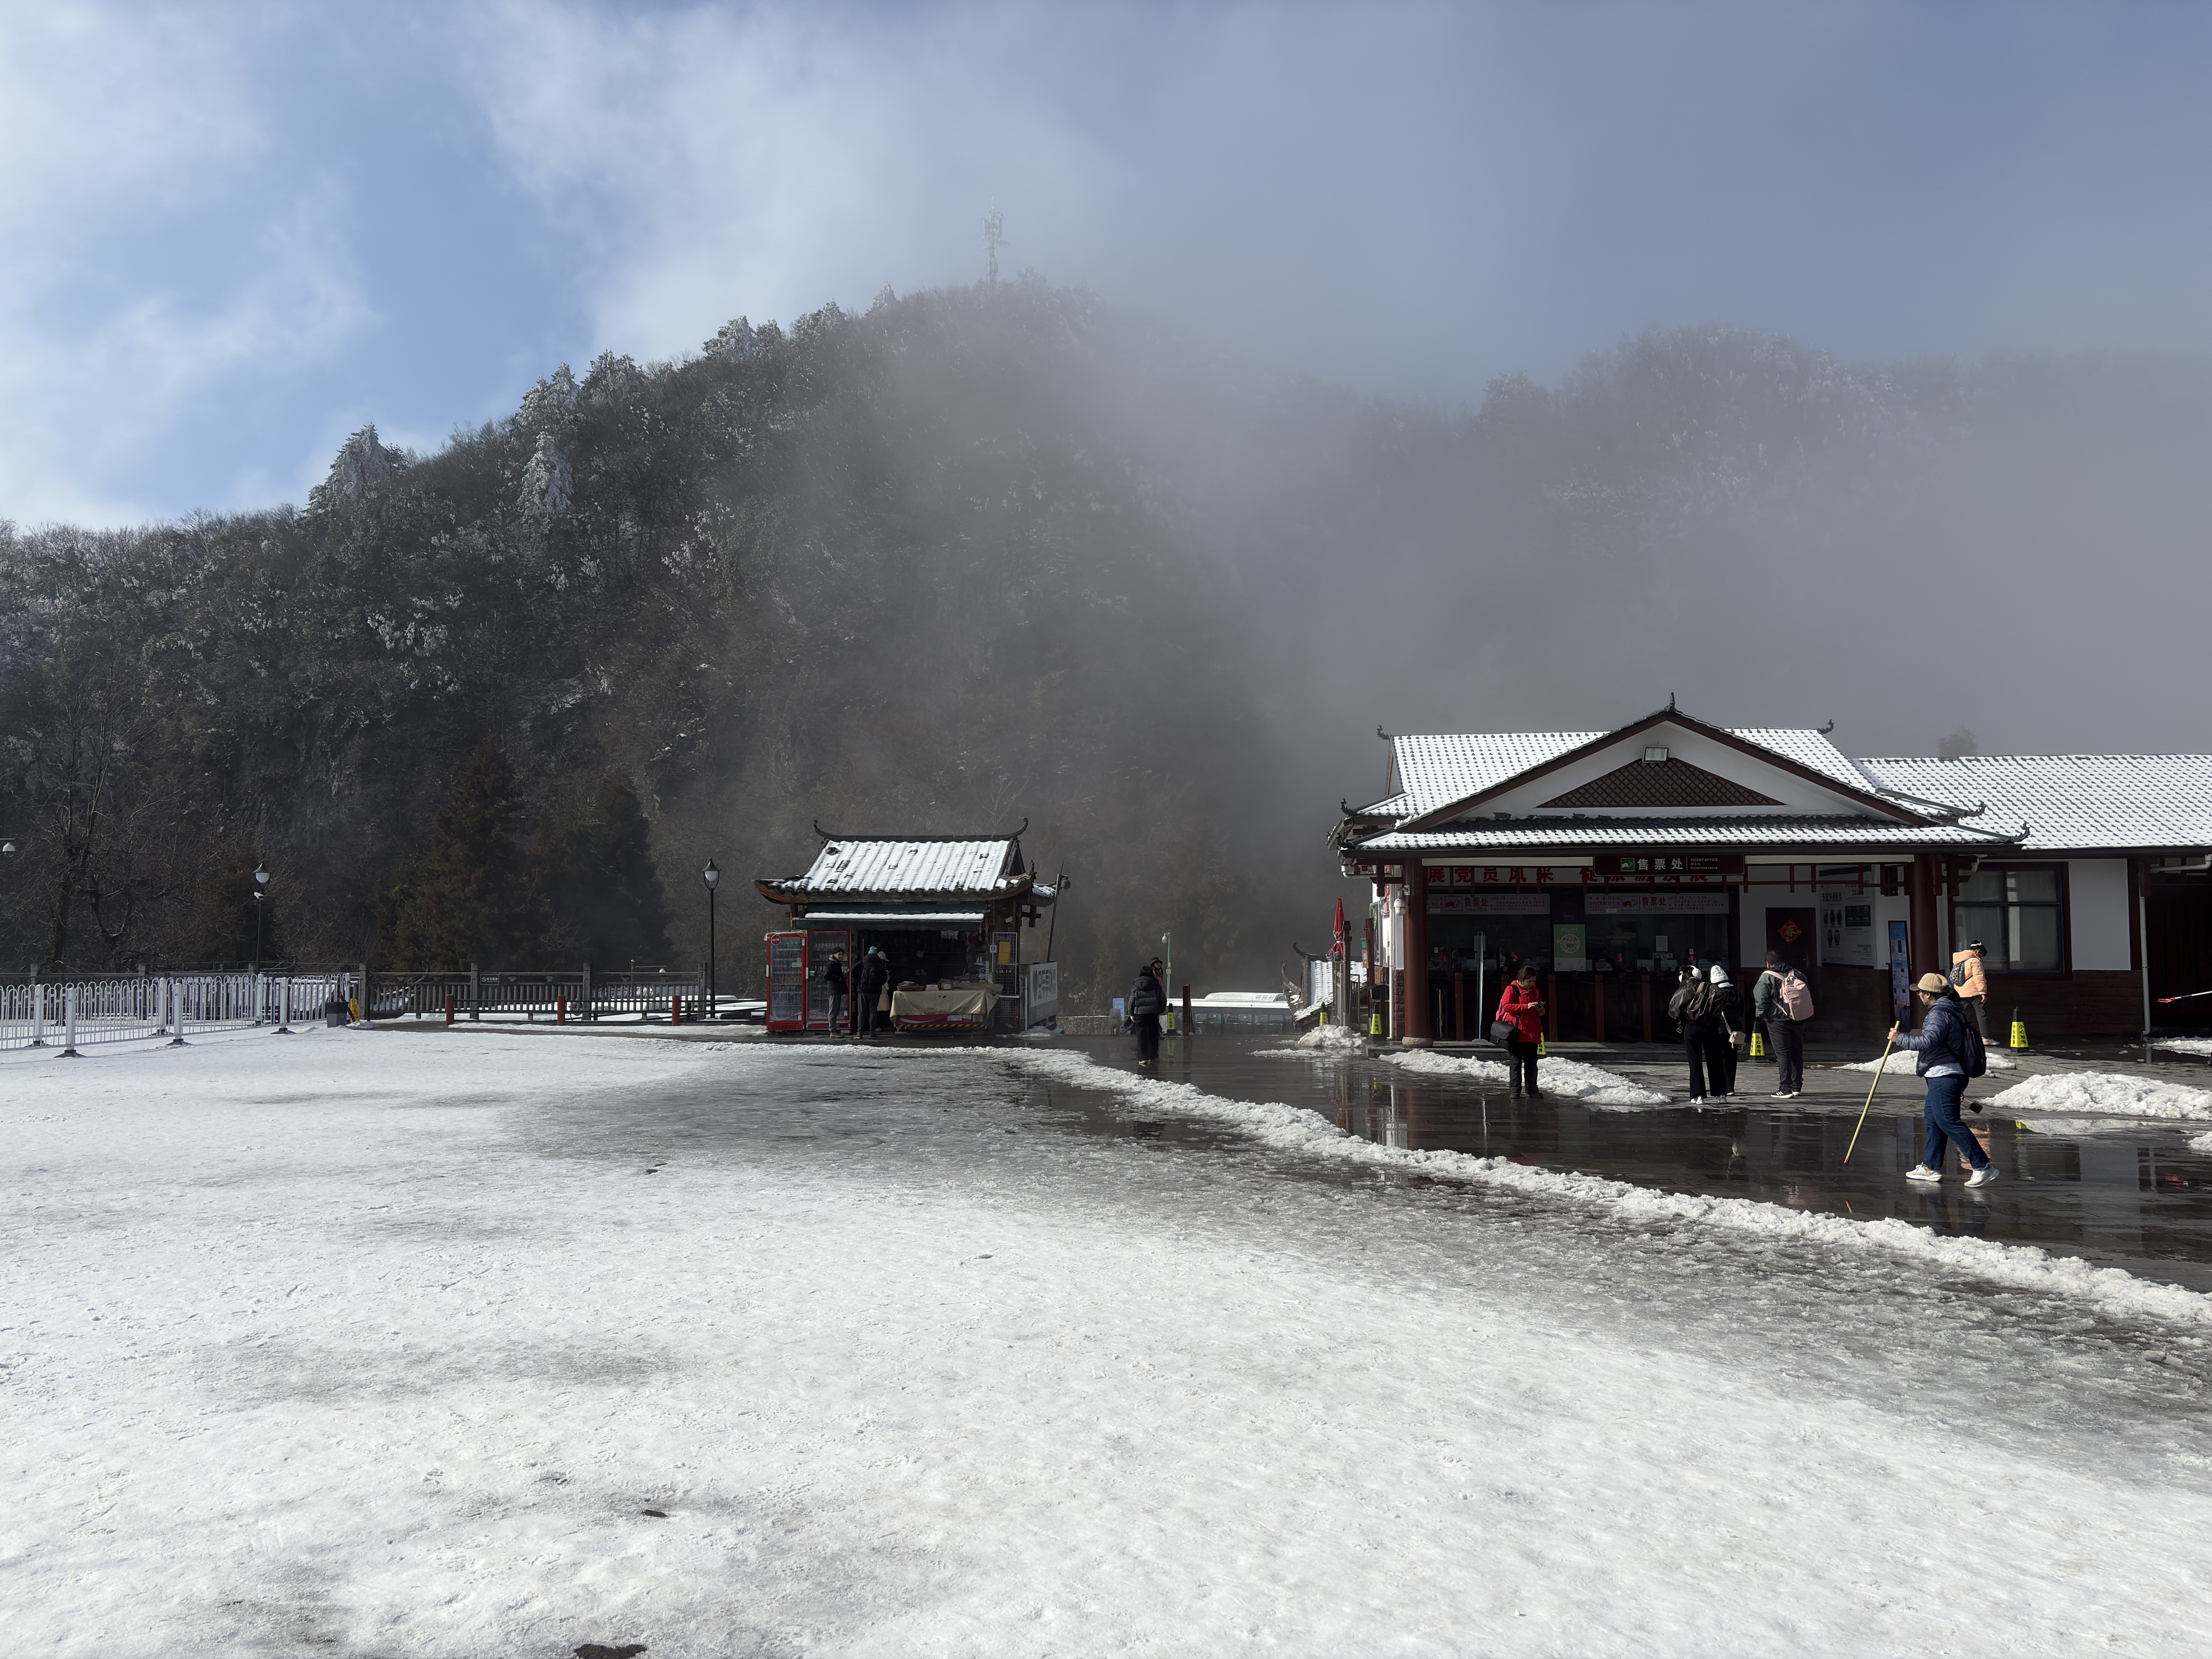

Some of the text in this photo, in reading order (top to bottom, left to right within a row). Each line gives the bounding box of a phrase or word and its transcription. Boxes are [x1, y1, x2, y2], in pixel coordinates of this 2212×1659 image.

[1637, 858, 1683, 870] 售票处
[1464, 897, 1489, 907] 售票处
[1642, 896, 1667, 906] 售票处
